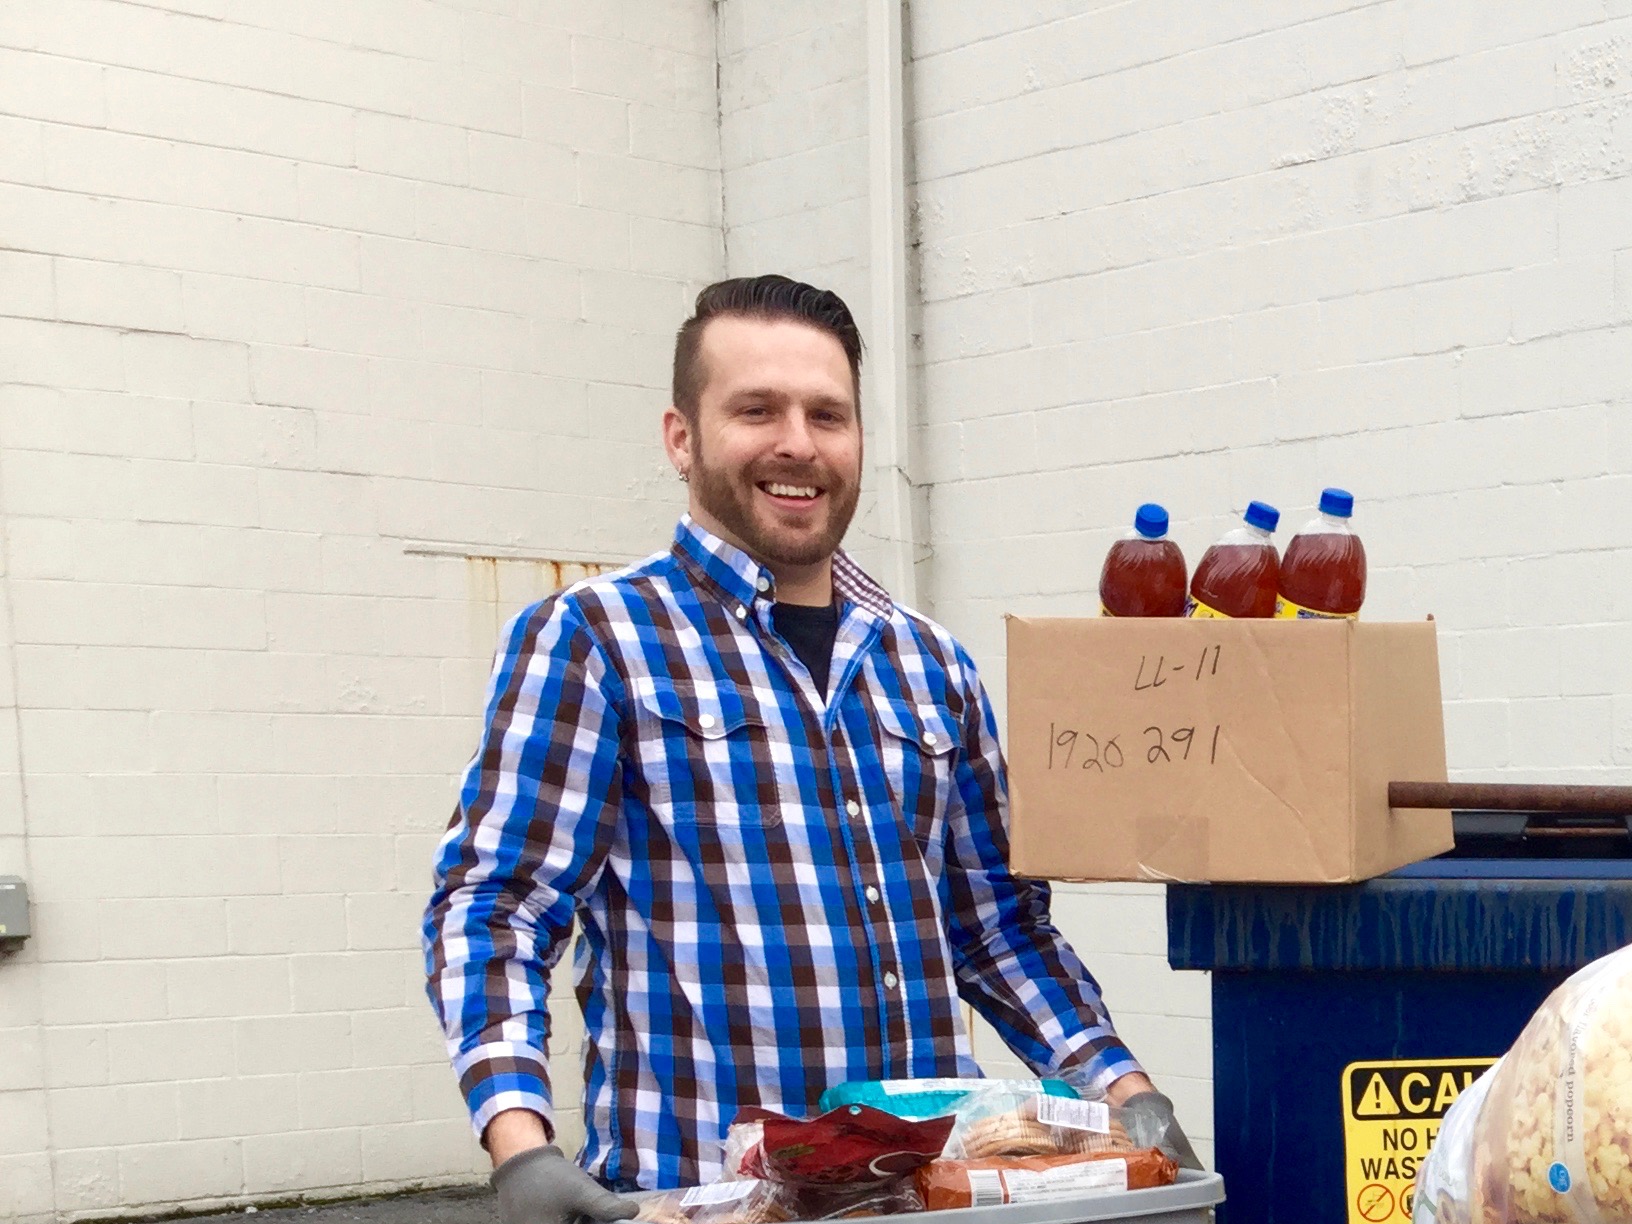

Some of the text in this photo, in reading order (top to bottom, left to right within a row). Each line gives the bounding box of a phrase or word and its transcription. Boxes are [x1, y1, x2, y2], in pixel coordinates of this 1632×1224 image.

[1048, 722, 1124, 773] 1920
[1563, 1081, 1575, 1143] popcorn
[1383, 1127, 1418, 1151] NO
